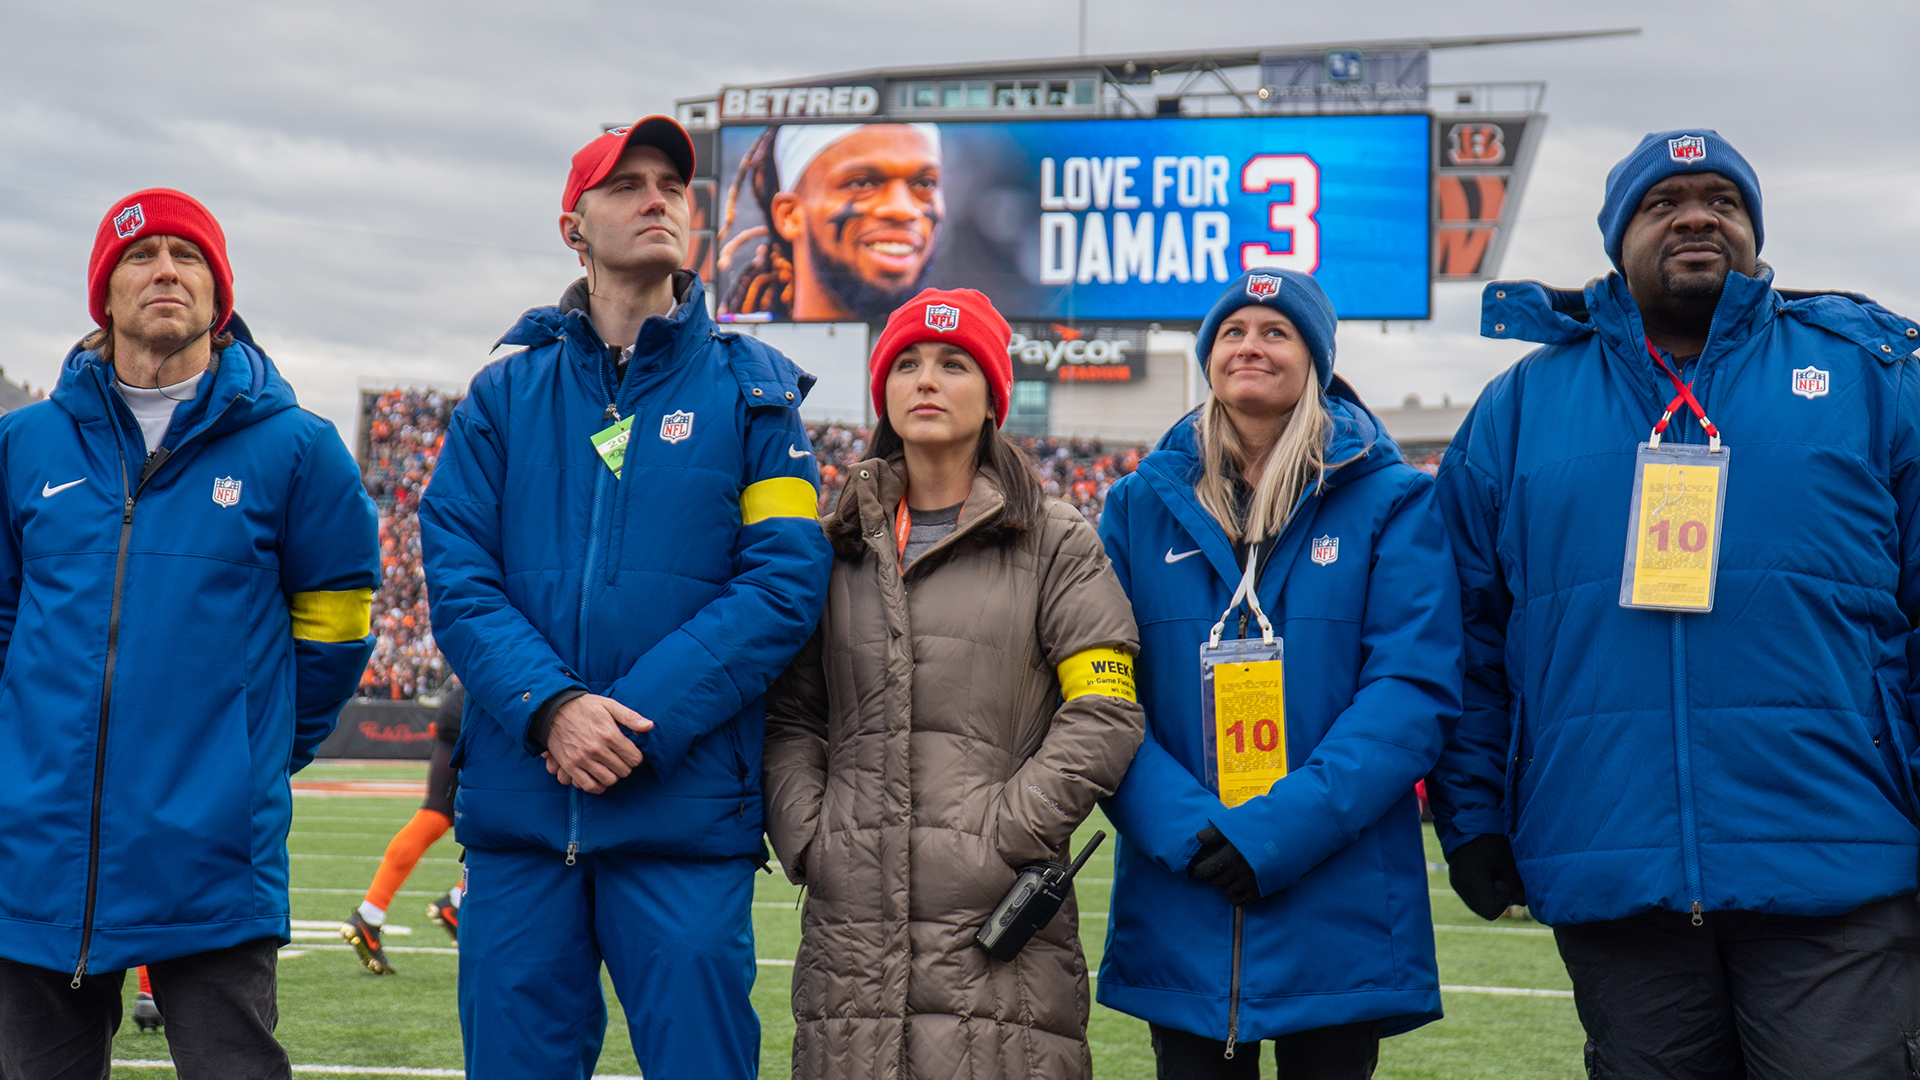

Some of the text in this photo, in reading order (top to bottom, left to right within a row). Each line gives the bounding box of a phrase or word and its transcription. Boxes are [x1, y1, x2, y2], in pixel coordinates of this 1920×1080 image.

[722, 86, 879, 117] BETFRED
[1675, 146, 1701, 158] NFL
[1040, 155, 1230, 210] LOVE FOR
[1241, 154, 1320, 275] 3
[1039, 211, 1230, 285] DAMAR
[1252, 282, 1275, 294] NFL
[929, 313, 954, 328] NFL
[1007, 333, 1131, 372] Paycor
[1799, 379, 1823, 391] NFL
[664, 423, 686, 437] NFL
[216, 488, 236, 502] NFL
[1649, 519, 1707, 553] 10
[1315, 547, 1335, 560] NFL
[1091, 660, 1131, 678] WEEK
[1226, 719, 1279, 754] 10
